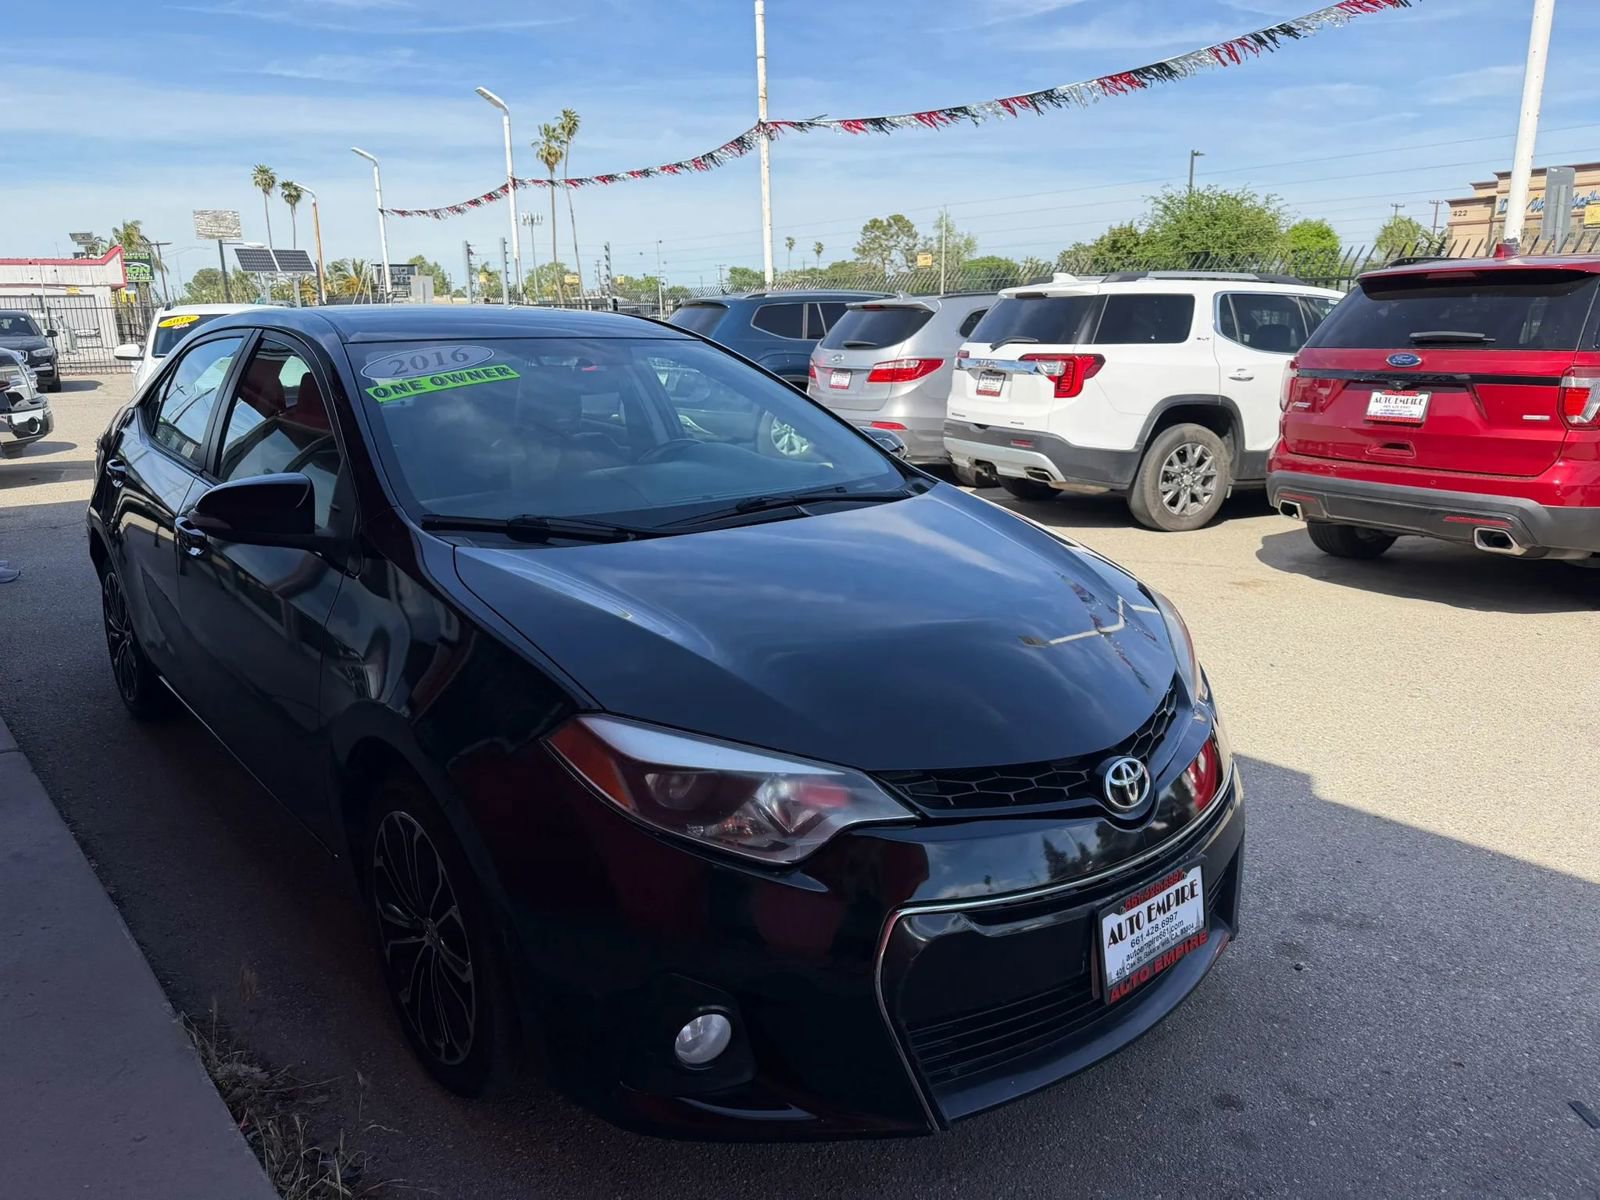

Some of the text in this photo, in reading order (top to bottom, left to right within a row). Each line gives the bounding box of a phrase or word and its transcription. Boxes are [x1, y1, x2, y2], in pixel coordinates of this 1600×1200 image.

[1453, 209, 1468, 217] 422
[387, 346, 470, 376] 2016
[372, 366, 515, 399] ONE OWNER
[1107, 879, 1199, 949] AUTO EMPIRE
[1130, 911, 1179, 948] 661.428.6997
[1110, 929, 1209, 1005] AUTO EMPIRE
